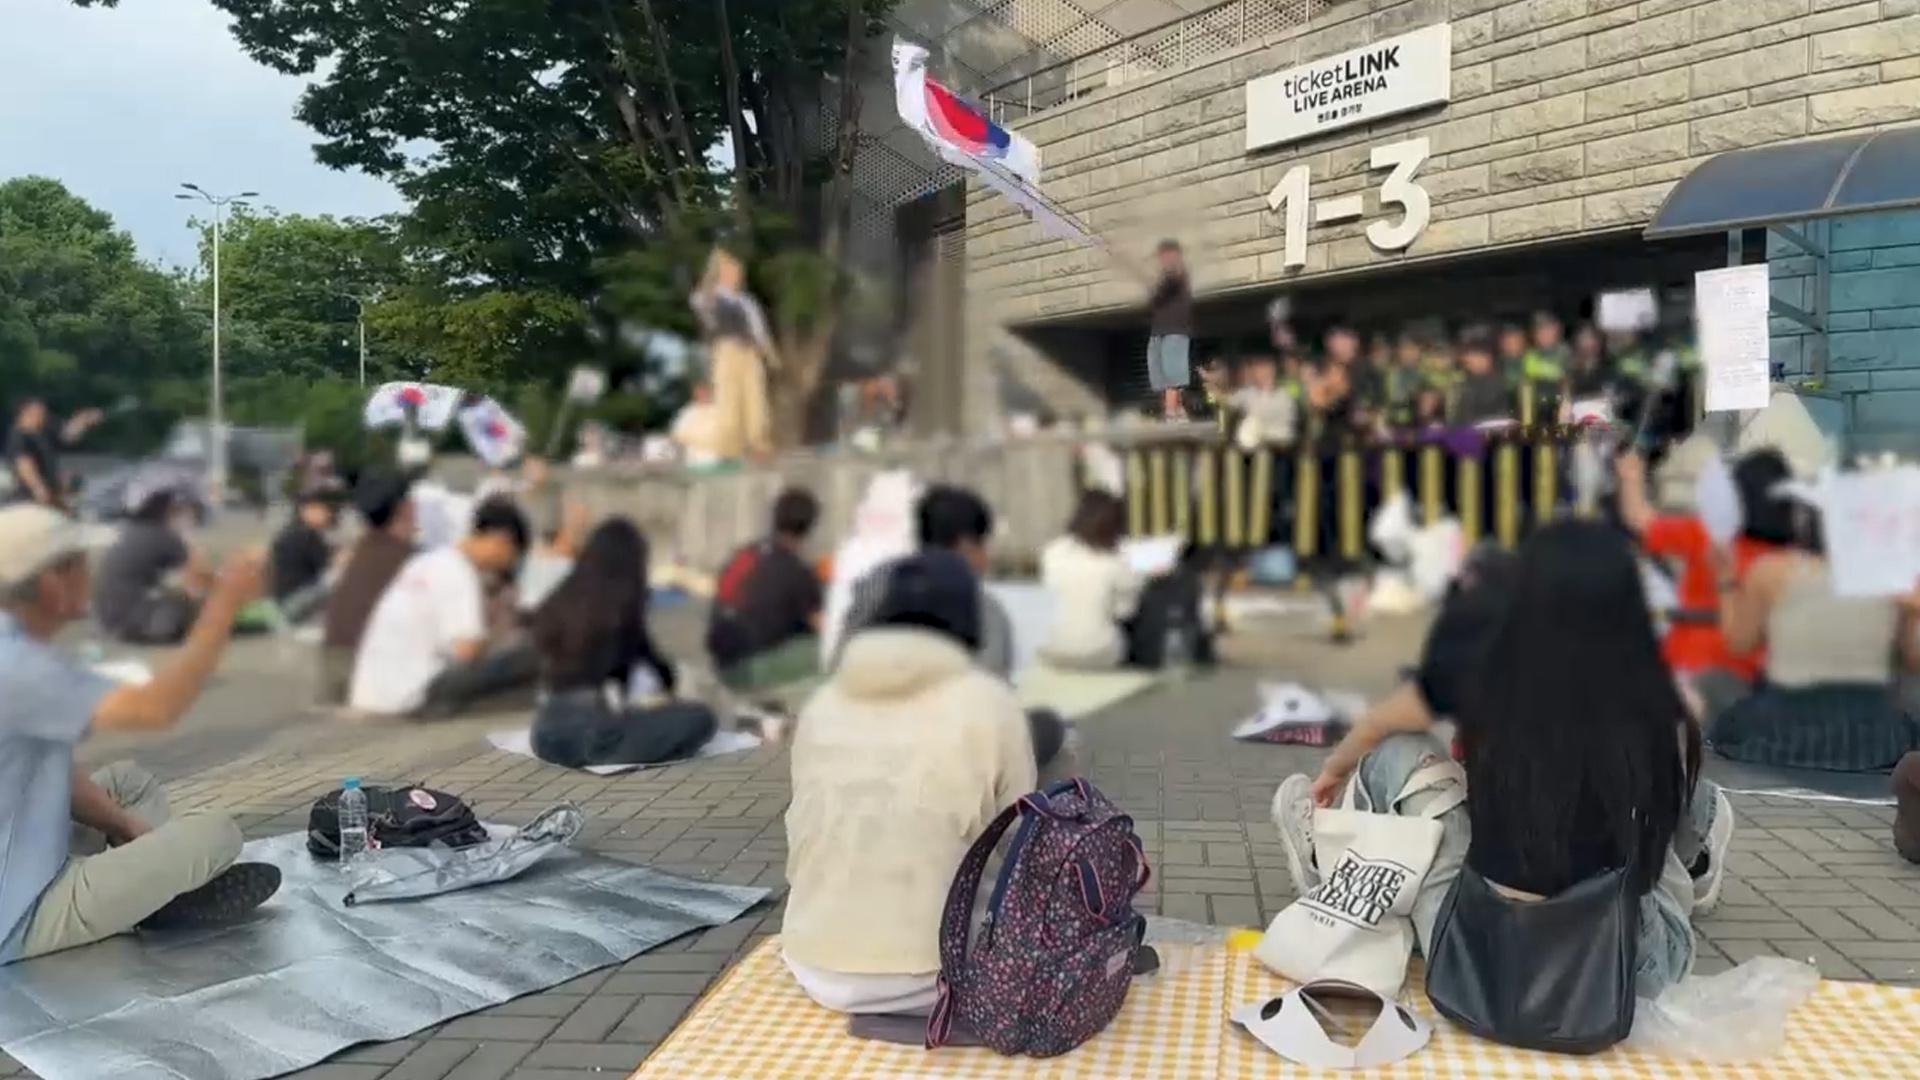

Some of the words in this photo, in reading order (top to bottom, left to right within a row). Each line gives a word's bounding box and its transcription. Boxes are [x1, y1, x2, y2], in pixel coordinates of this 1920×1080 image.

[1284, 45, 1399, 98] ticketLINK
[1294, 90, 1328, 113] LIVE
[1330, 75, 1387, 103] ARENA
[1267, 137, 1430, 269] 1-3
